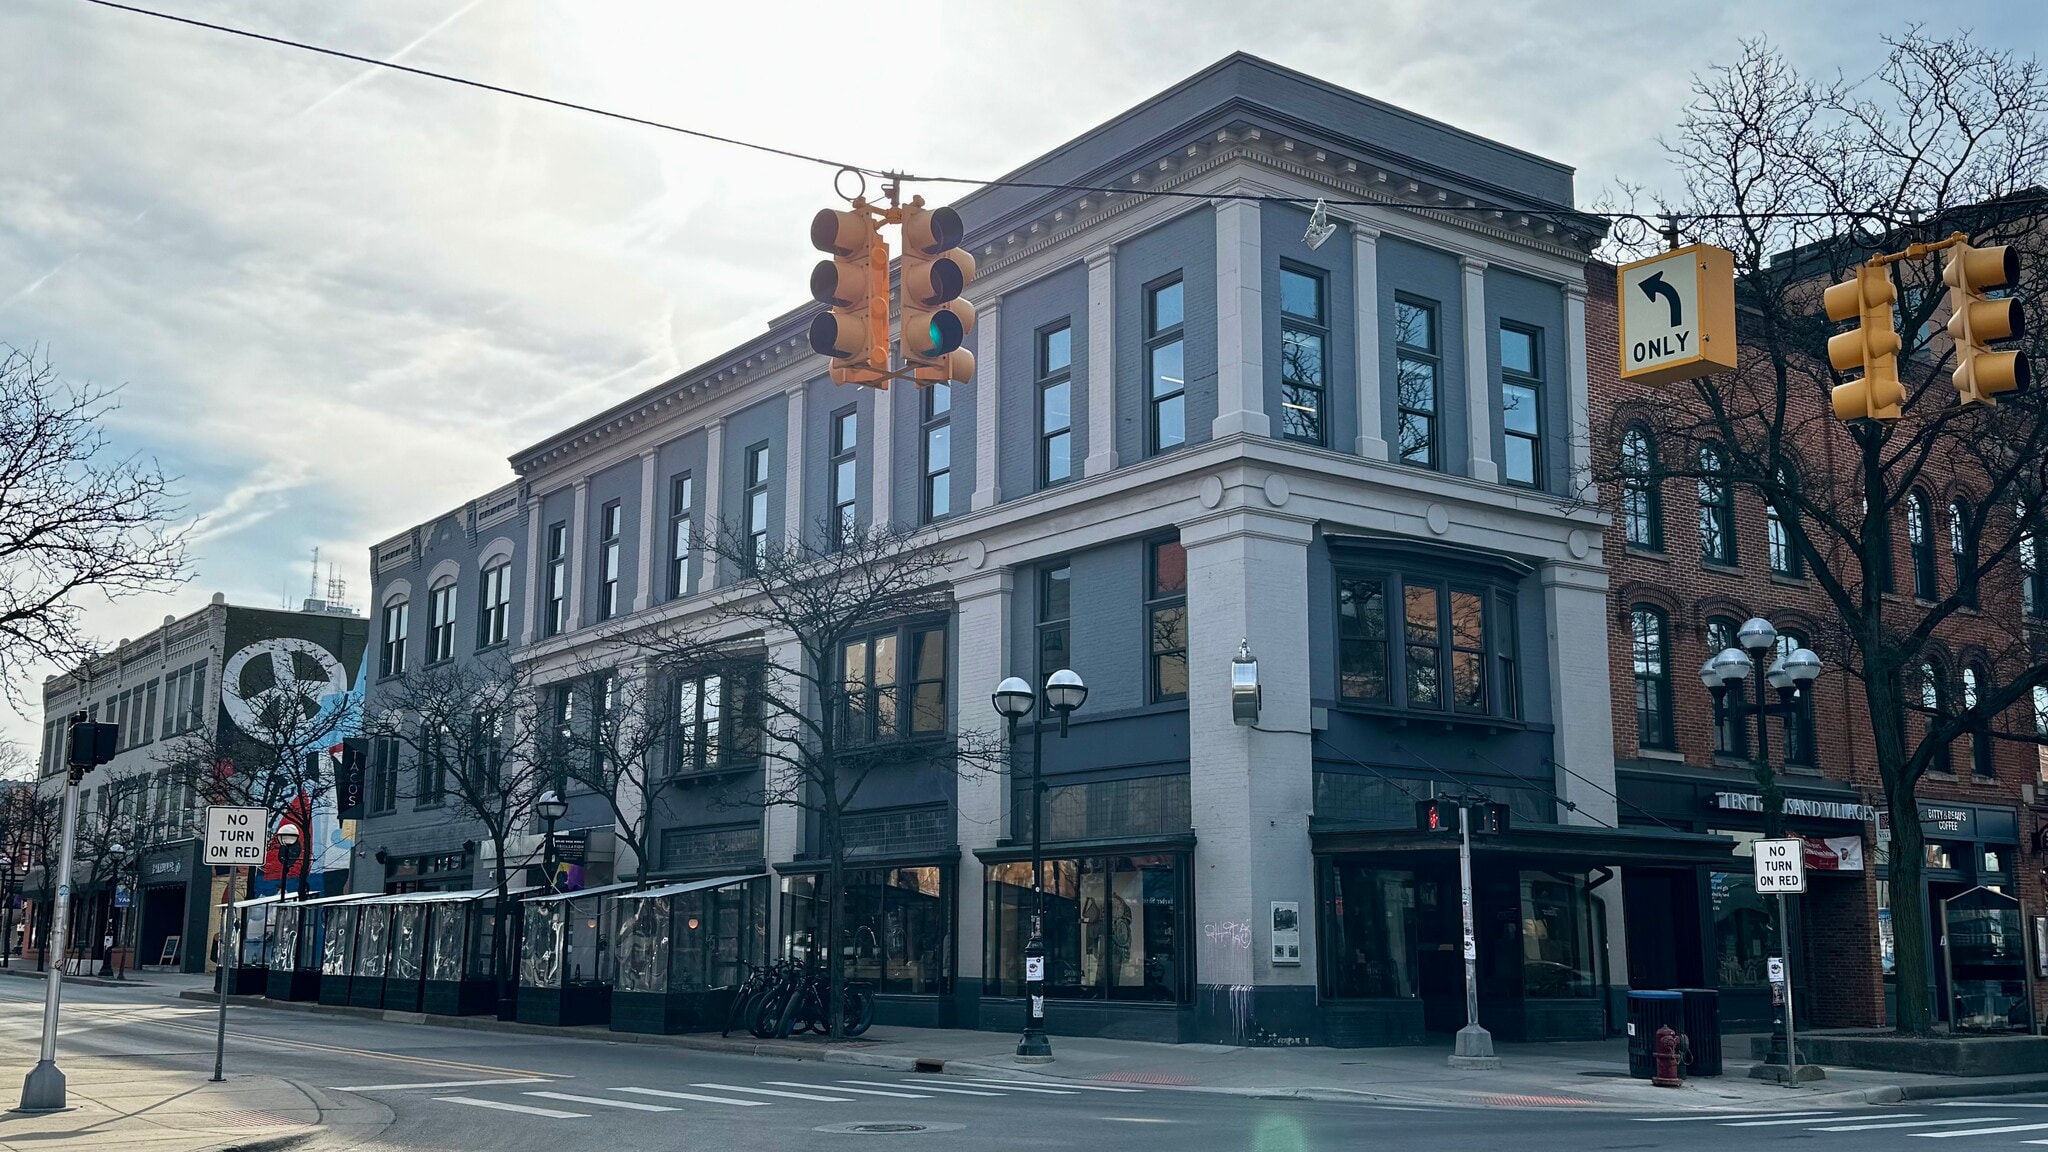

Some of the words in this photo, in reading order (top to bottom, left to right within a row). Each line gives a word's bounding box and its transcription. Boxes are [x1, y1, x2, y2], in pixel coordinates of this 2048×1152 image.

[1633, 330, 1690, 363] ONLY
[348, 750, 360, 807] TACOS
[1717, 791, 1748, 810] TEN
[1821, 801, 1875, 821] VILLAGES
[227, 814, 248, 826] NO
[1938, 820, 1958, 831] COFFEE
[219, 830, 254, 842] TURN
[210, 845, 228, 858] ON
[235, 846, 260, 858] RED
[1769, 846, 1786, 857] NO
[1765, 860, 1792, 872] TURN
[1760, 876, 1774, 887] ON
[1779, 875, 1799, 886] RED
